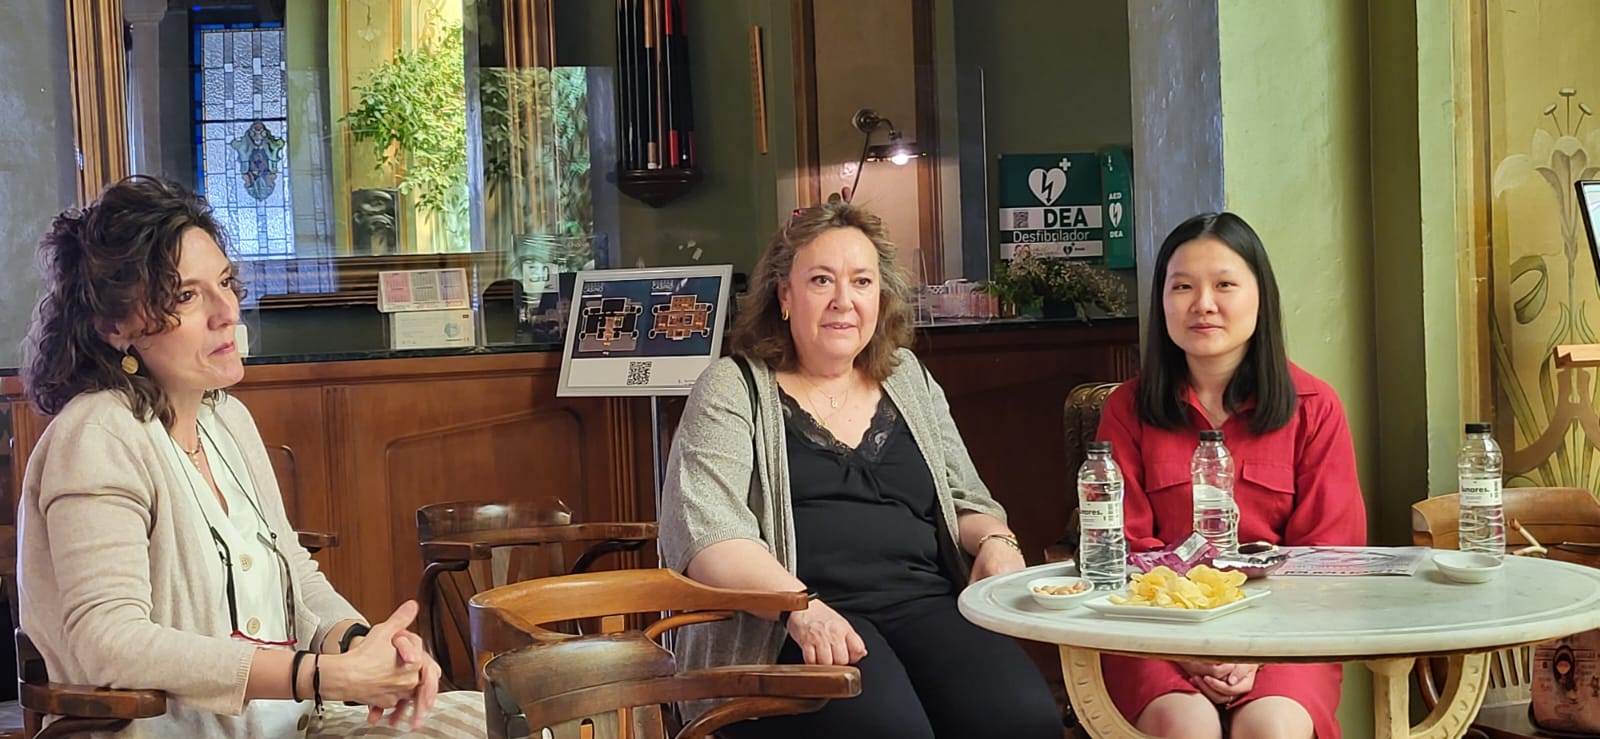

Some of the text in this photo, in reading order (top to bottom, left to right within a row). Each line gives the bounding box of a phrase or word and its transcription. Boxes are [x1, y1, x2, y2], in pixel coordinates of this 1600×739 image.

[1108, 192, 1122, 200] AED
[1043, 208, 1088, 228] DEA
[1109, 230, 1124, 239] DEA
